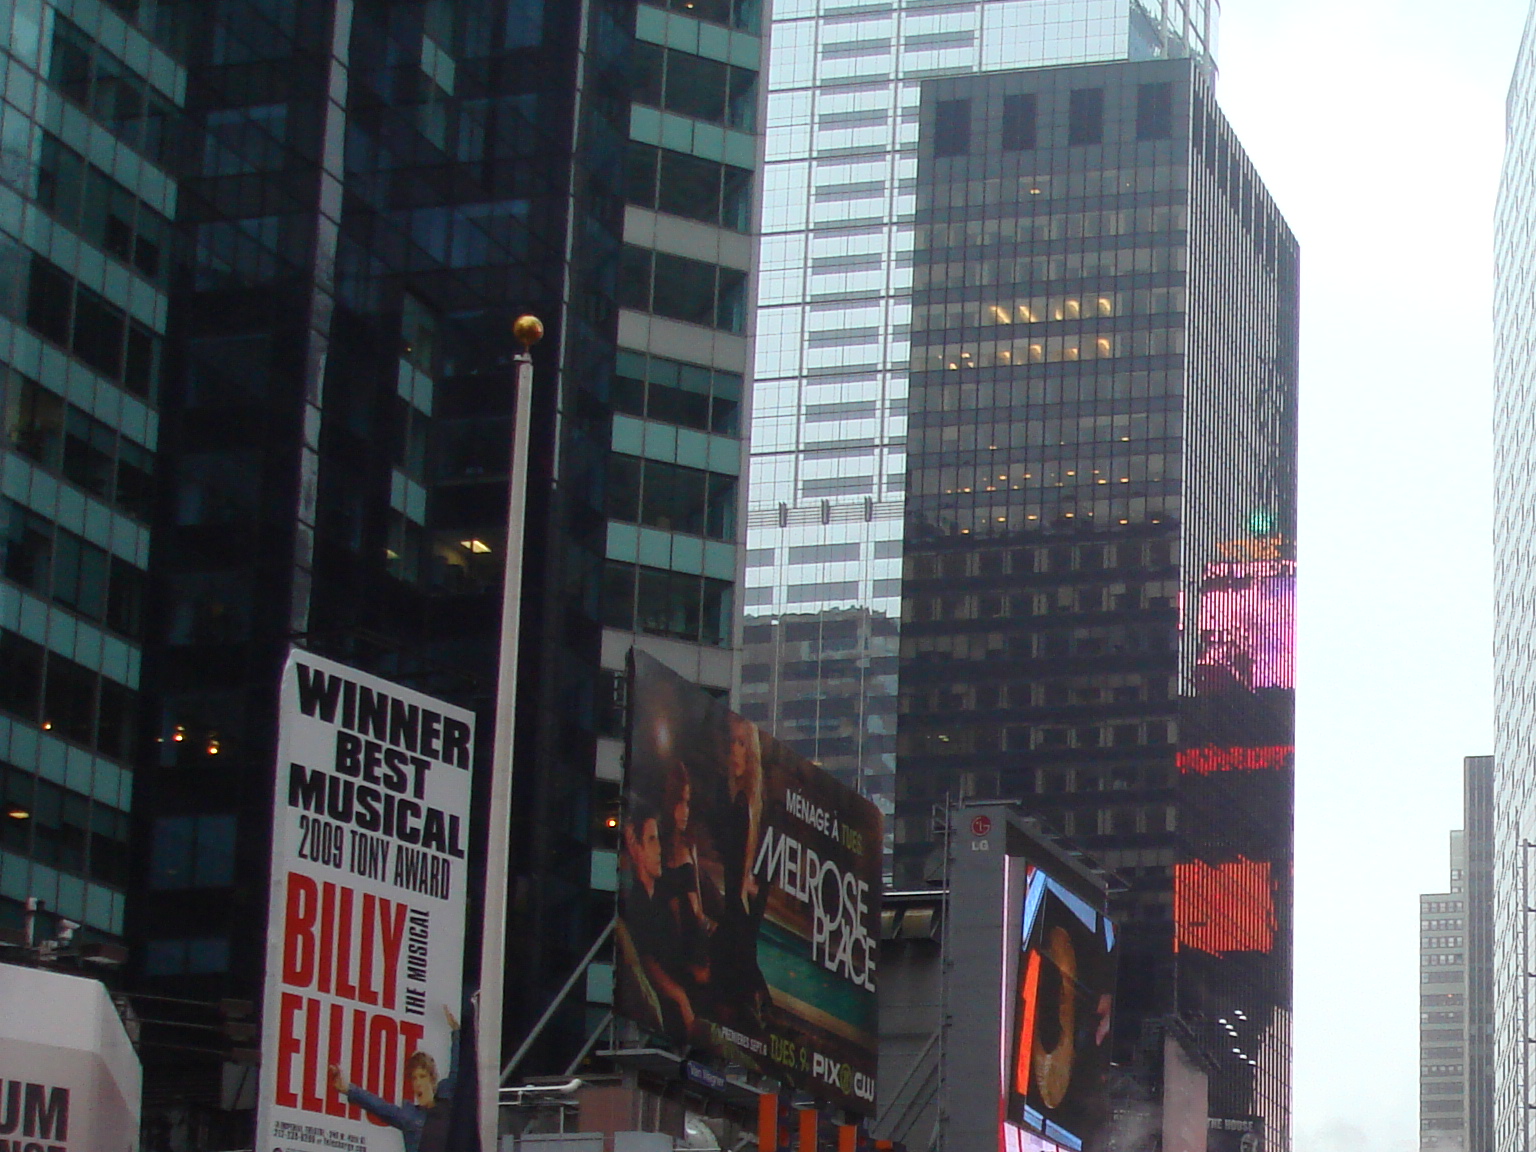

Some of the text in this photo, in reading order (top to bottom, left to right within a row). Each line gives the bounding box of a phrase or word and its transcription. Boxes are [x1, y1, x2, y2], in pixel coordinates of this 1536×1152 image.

[296, 662, 471, 771] WINNER
[288, 763, 465, 859] MUSICAL
[335, 730, 431, 800] BEST
[298, 815, 451, 900] 2009 TONY AWARD
[754, 826, 869, 937] MELROSE
[971, 840, 989, 851] LG
[281, 872, 408, 1011] BILLY
[406, 908, 430, 1017] THE MUSICAL
[813, 907, 876, 993] PLACE
[274, 994, 424, 1128] ELLIOT
[813, 1052, 840, 1087] PIX
